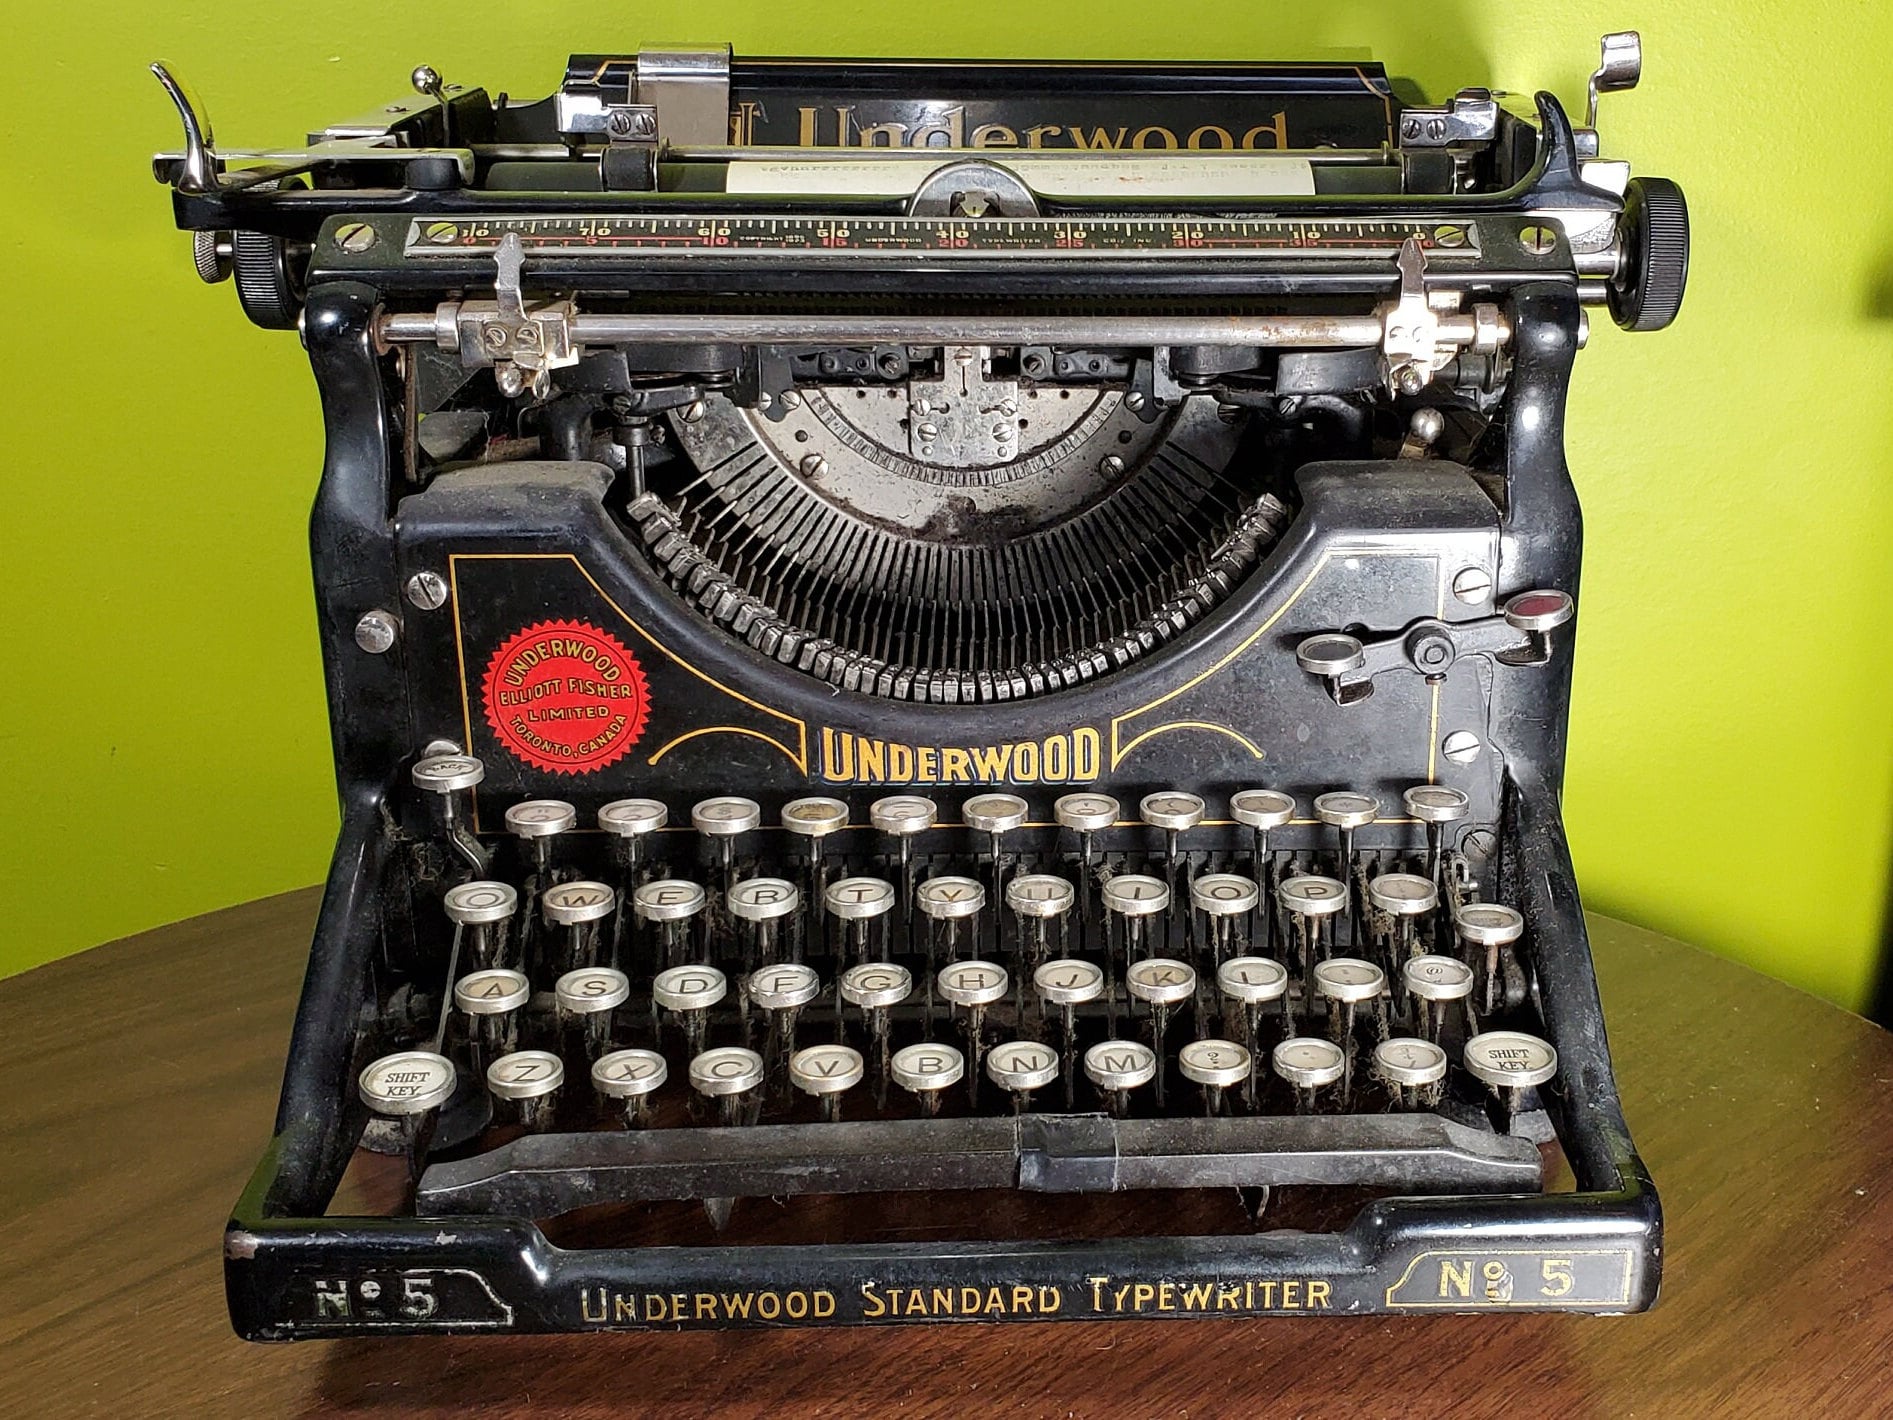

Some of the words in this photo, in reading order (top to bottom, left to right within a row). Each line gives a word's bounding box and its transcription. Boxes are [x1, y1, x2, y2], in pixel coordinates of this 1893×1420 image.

[698, 228, 731, 236] 60
[817, 228, 850, 237] 50
[936, 229, 970, 239] 40
[1054, 231, 1087, 239] 30
[1171, 231, 1204, 239] 20
[504, 639, 621, 687] UNDERWOOD
[500, 679, 561, 706] ELLIOTT
[567, 678, 633, 699] FISHER
[528, 706, 609, 722] LIMITED
[818, 726, 1100, 785] UNDERWOOD
[562, 895, 599, 906] W
[754, 890, 779, 904] R
[848, 889, 874, 903] T
[940, 889, 963, 902] Y
[1210, 886, 1241, 899] O
[1304, 887, 1327, 899] P
[679, 979, 708, 993] D
[774, 976, 799, 993] F
[860, 975, 891, 990] G
[958, 974, 984, 988] H
[1055, 974, 1078, 987] J
[1152, 971, 1174, 985] K
[480, 982, 504, 998] A
[582, 980, 607, 996] S
[1488, 1049, 1529, 1058] SHIFT
[711, 1061, 743, 1077] C
[815, 1060, 839, 1076] V
[918, 1057, 943, 1073] B
[1012, 1056, 1038, 1072] N
[1104, 1054, 1137, 1071] M
[385, 1072, 430, 1083] SHIFT
[513, 1065, 540, 1081] Z
[614, 1064, 647, 1080] X
[1540, 1259, 1573, 1297] 5
[401, 1278, 435, 1317] 5
[581, 1288, 837, 1323] UNDERWOOD
[862, 1281, 1061, 1317] STANDARD
[1087, 1277, 1330, 1313] TYPEWRITER
